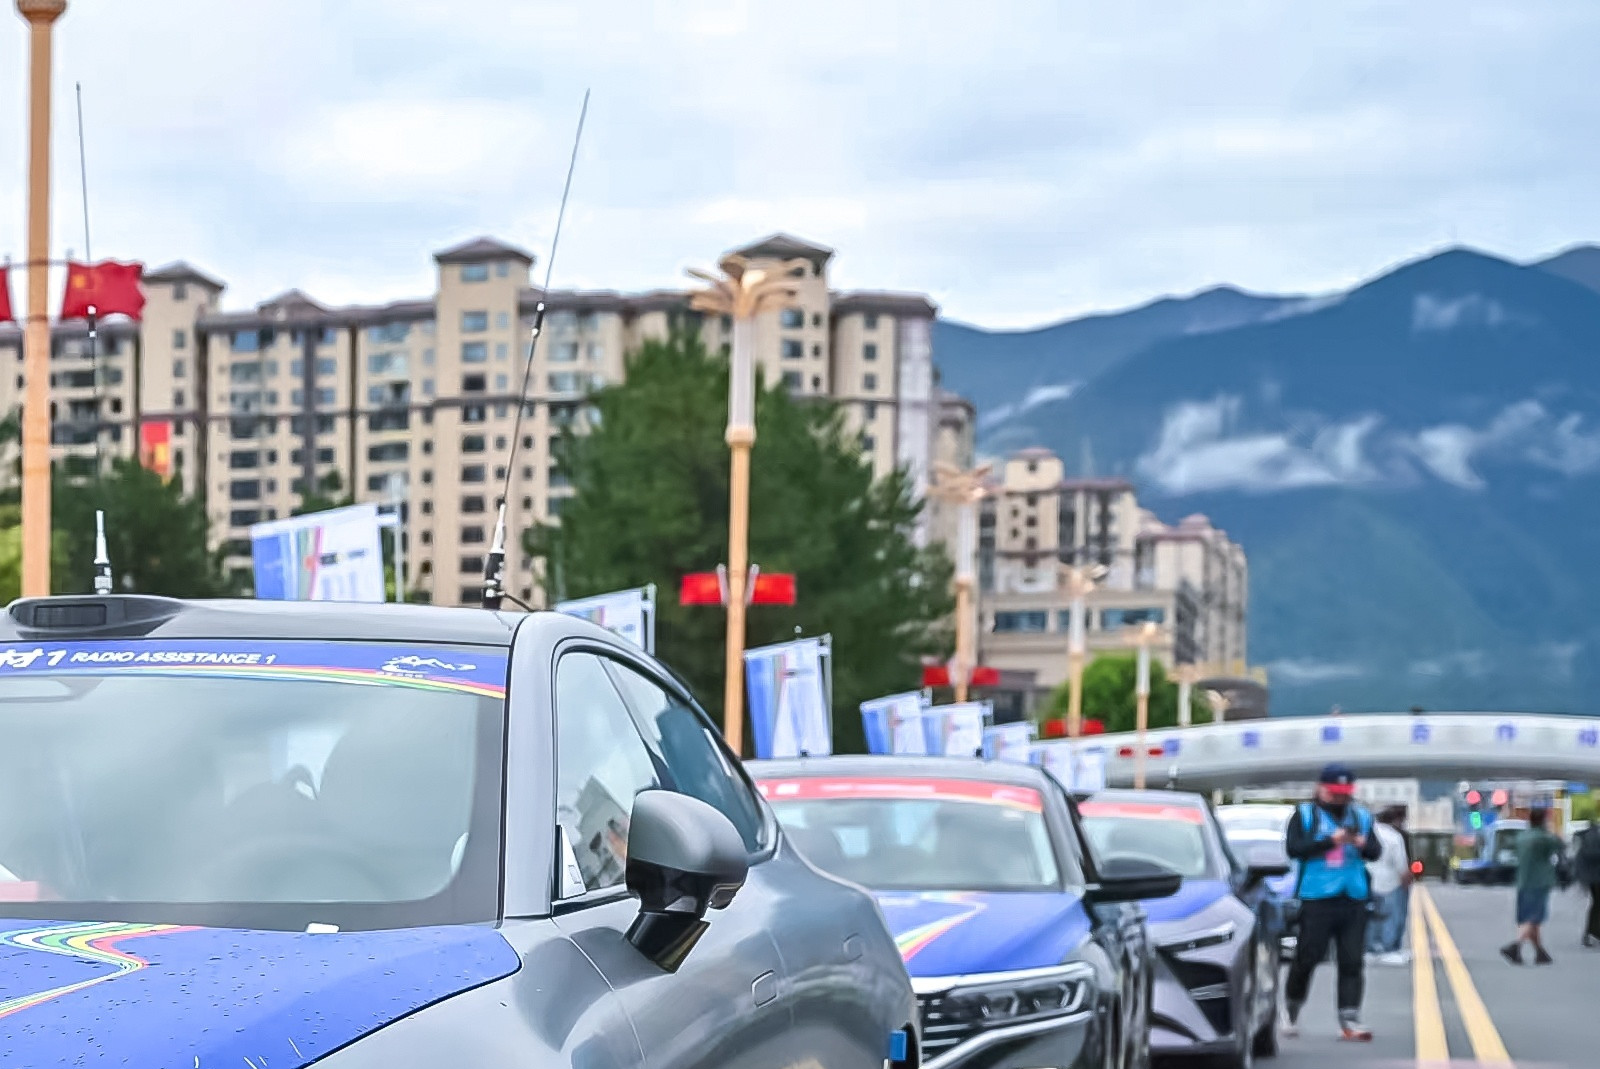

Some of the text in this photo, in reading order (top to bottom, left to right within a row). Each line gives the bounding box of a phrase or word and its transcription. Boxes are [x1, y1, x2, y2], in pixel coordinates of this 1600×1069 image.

[70, 652, 135, 664] RADIO
[137, 652, 263, 665] ASSISTANCE
[265, 653, 277, 665] 1
